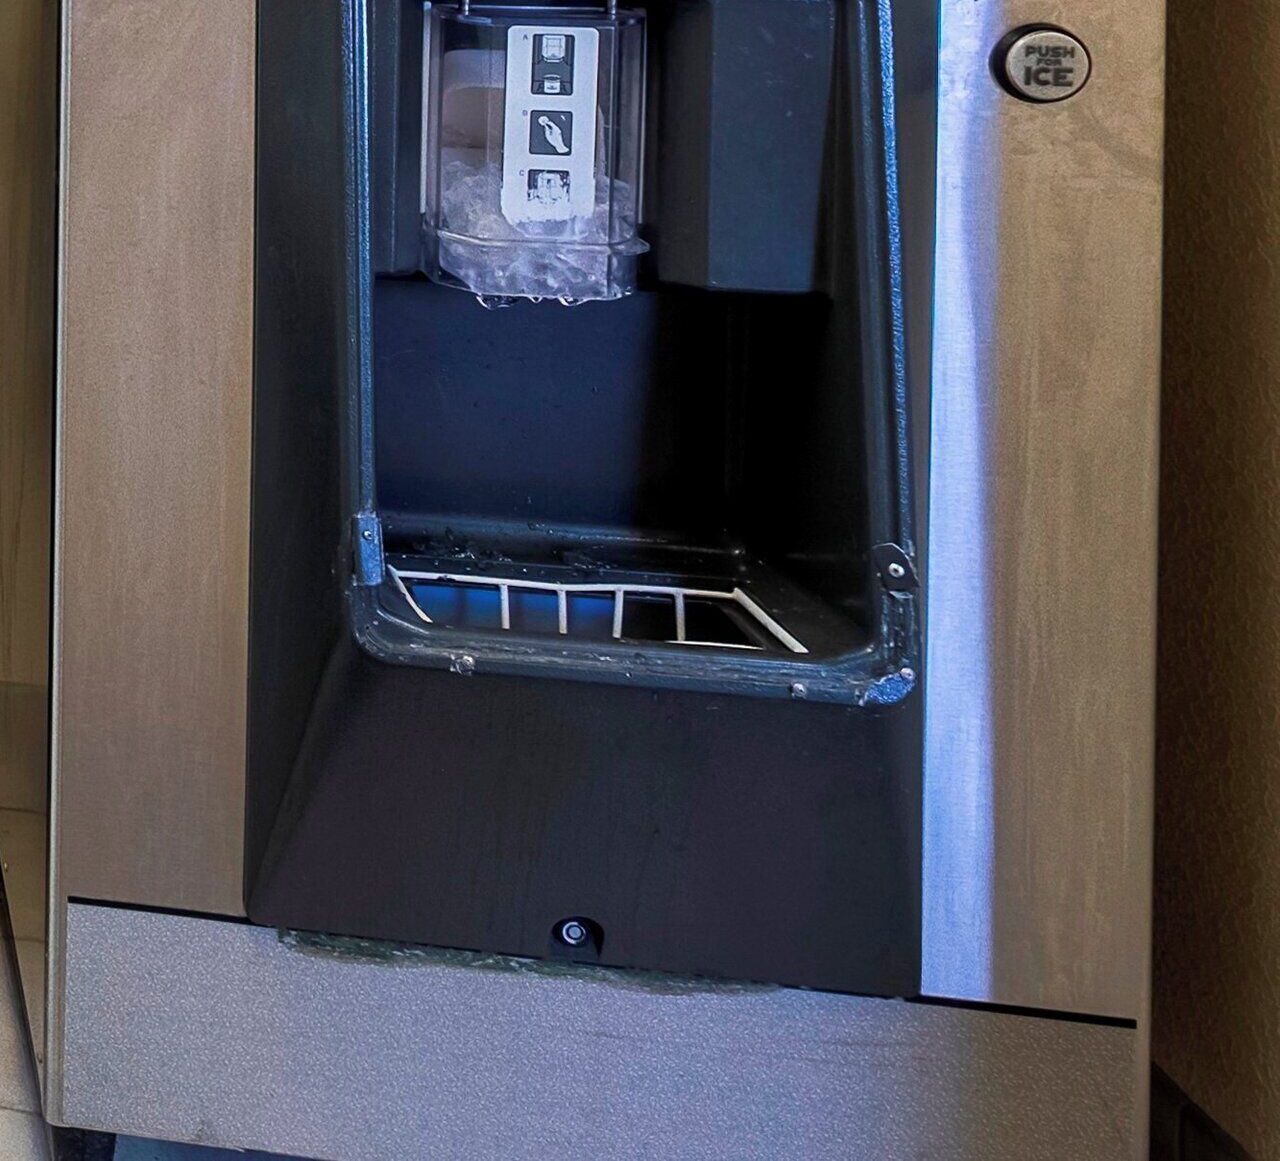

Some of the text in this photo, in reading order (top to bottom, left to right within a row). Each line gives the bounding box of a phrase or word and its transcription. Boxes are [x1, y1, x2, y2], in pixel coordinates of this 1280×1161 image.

[1024, 45, 1075, 58] PUSH
[1036, 58, 1062, 66] FOR
[1024, 66, 1074, 87] ICE
